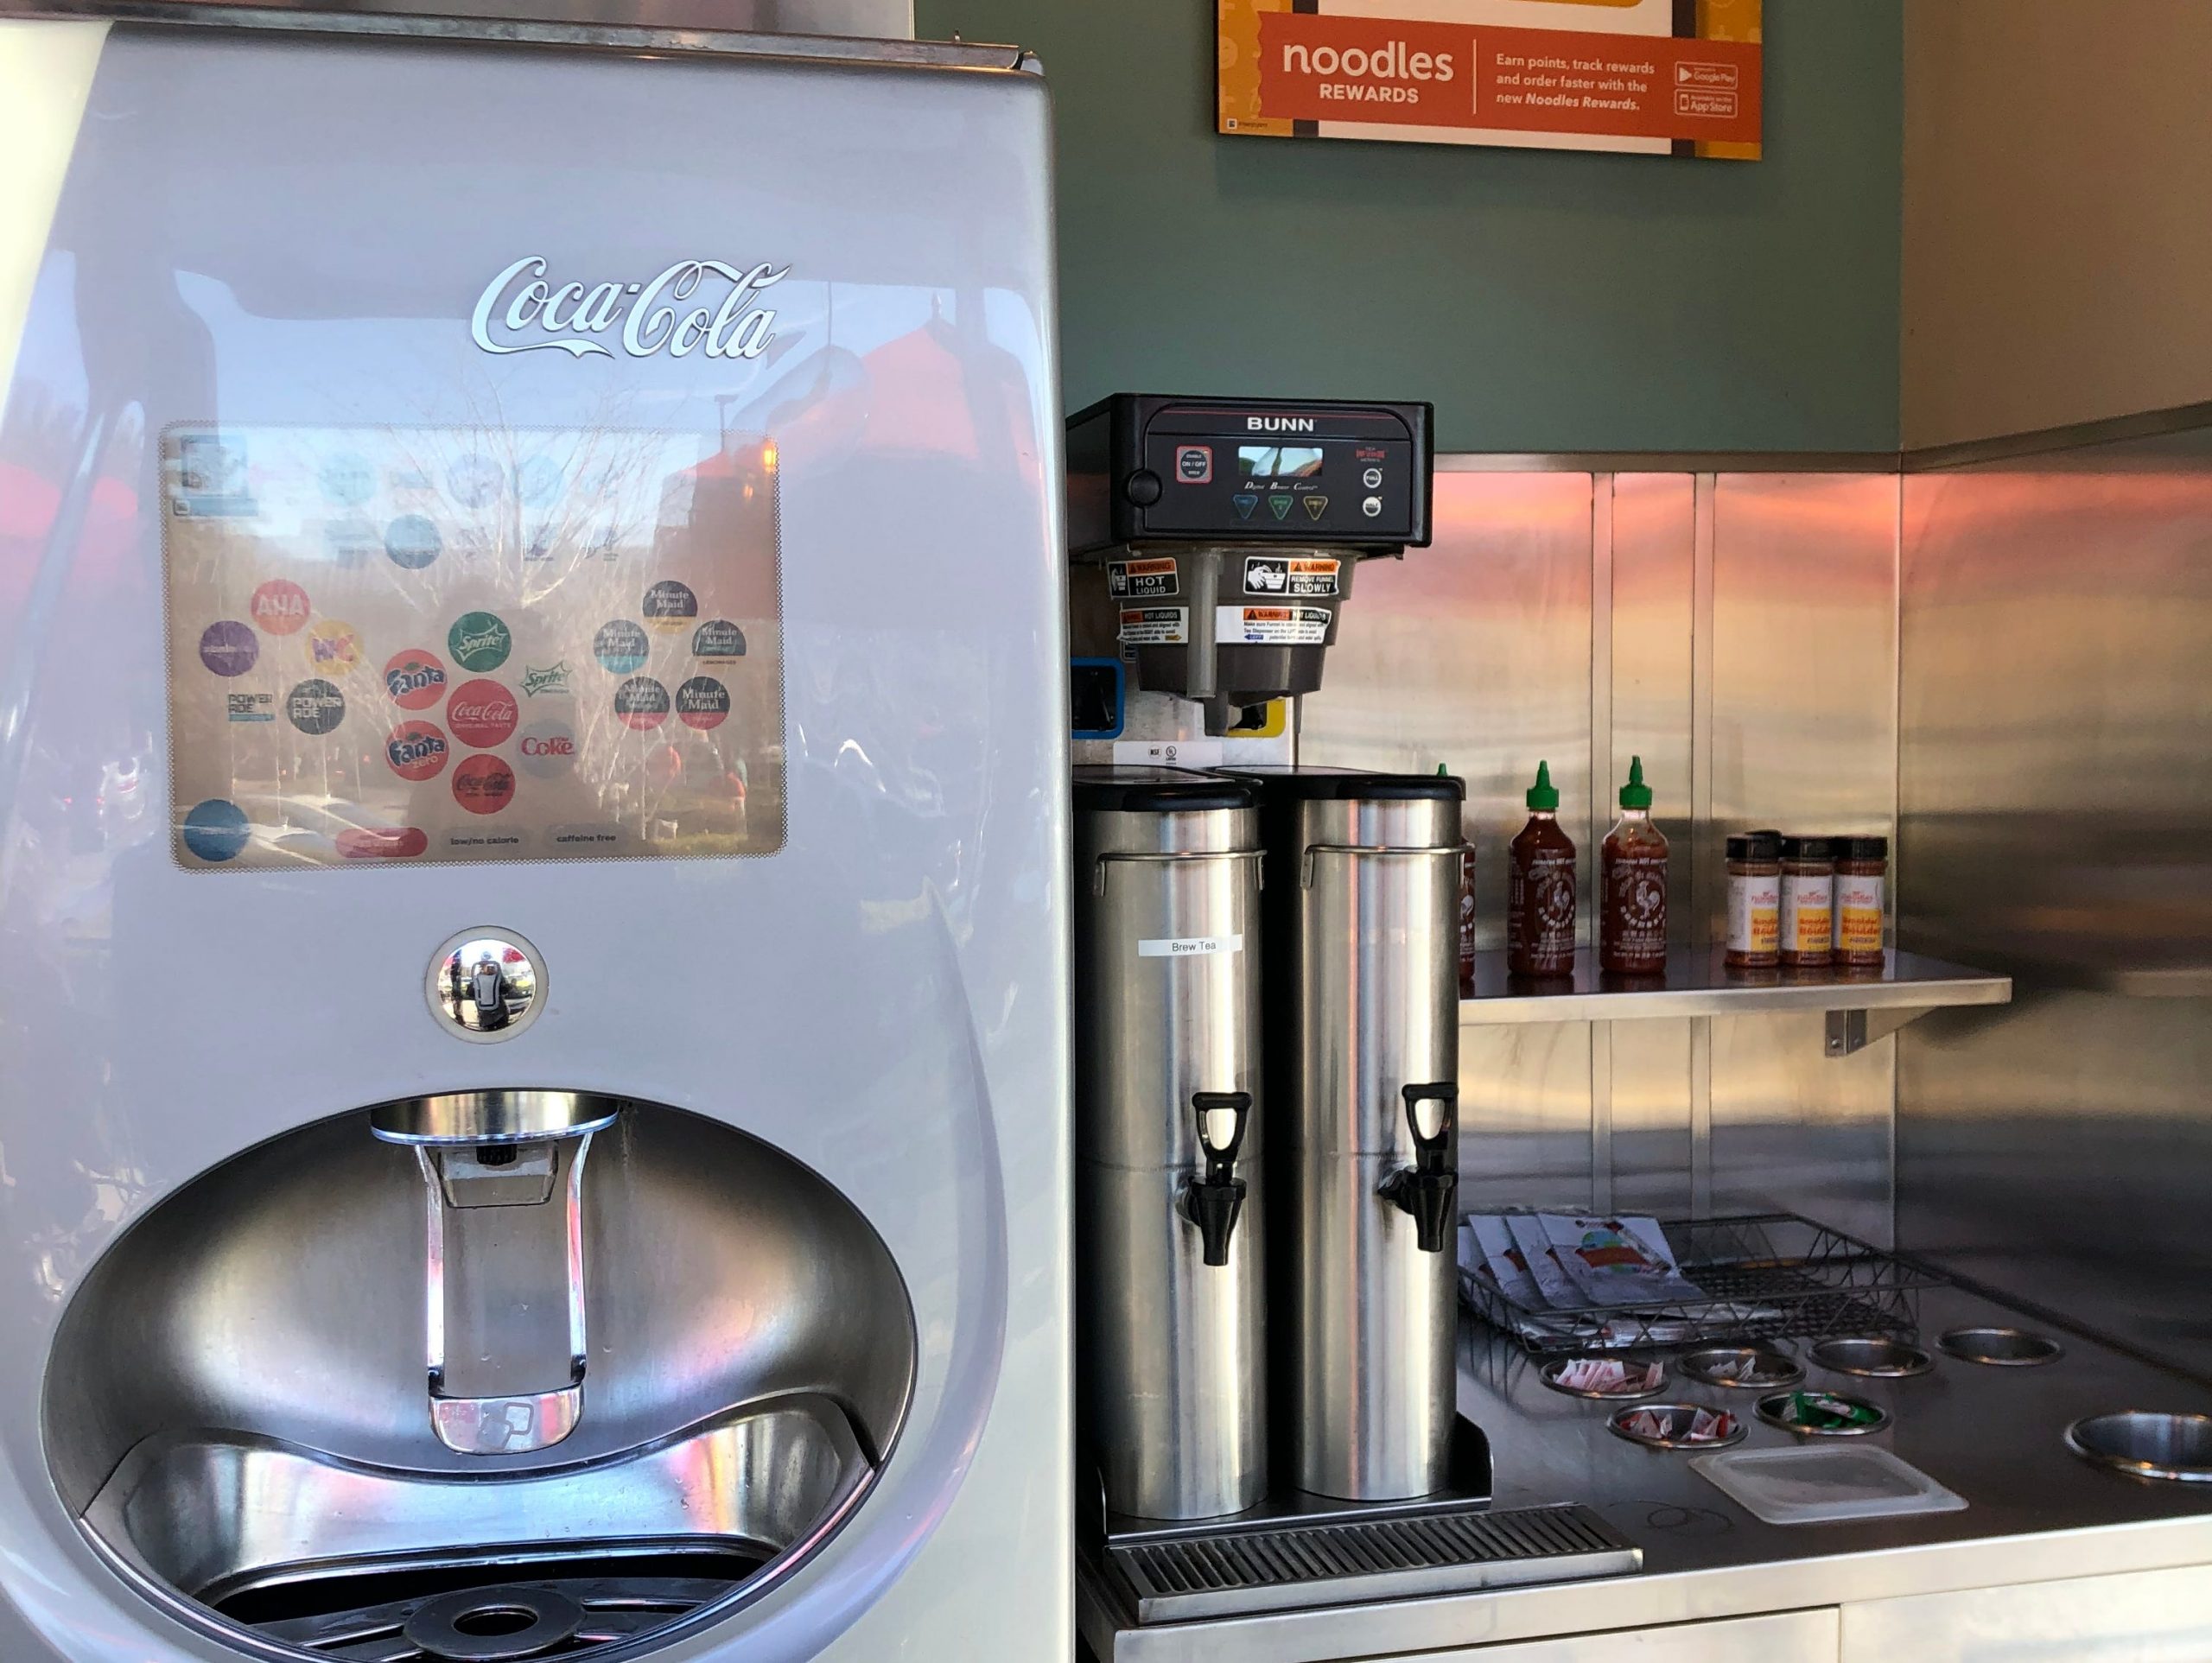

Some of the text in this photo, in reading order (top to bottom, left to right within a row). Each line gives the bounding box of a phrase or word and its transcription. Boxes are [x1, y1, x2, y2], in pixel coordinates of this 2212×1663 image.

[1283, 41, 1454, 82] noodles
[1496, 54, 1655, 74] Earn points, track rewards
[1496, 73, 1648, 92] and order faster with the
[1694, 71, 1720, 84] Google
[1319, 83, 1419, 104] REWARDS
[1497, 92, 1640, 111] new Noodles Rewards.
[1691, 101, 1709, 113] App
[471, 255, 793, 359] Coca-Cola
[1247, 416, 1314, 432] BUNN
[1135, 576, 1165, 587] HOT
[1294, 583, 1331, 593] SLOWLY
[651, 589, 690, 600] Minute
[657, 600, 683, 609] Maid
[461, 634, 499, 650] Sprite
[386, 665, 446, 696] Fanta
[525, 671, 564, 688] Sprite
[682, 689, 725, 699] Minute
[292, 696, 342, 708] POWER
[688, 699, 719, 710] Maid
[452, 700, 513, 721] Coca-Cola
[389, 735, 446, 767] Fanta
[521, 736, 575, 756] Coke
[411, 755, 438, 768] zero
[450, 835, 518, 846] low/no calorie
[556, 834, 616, 843] caffeine free
[1172, 942, 1216, 951] Brew Tea
